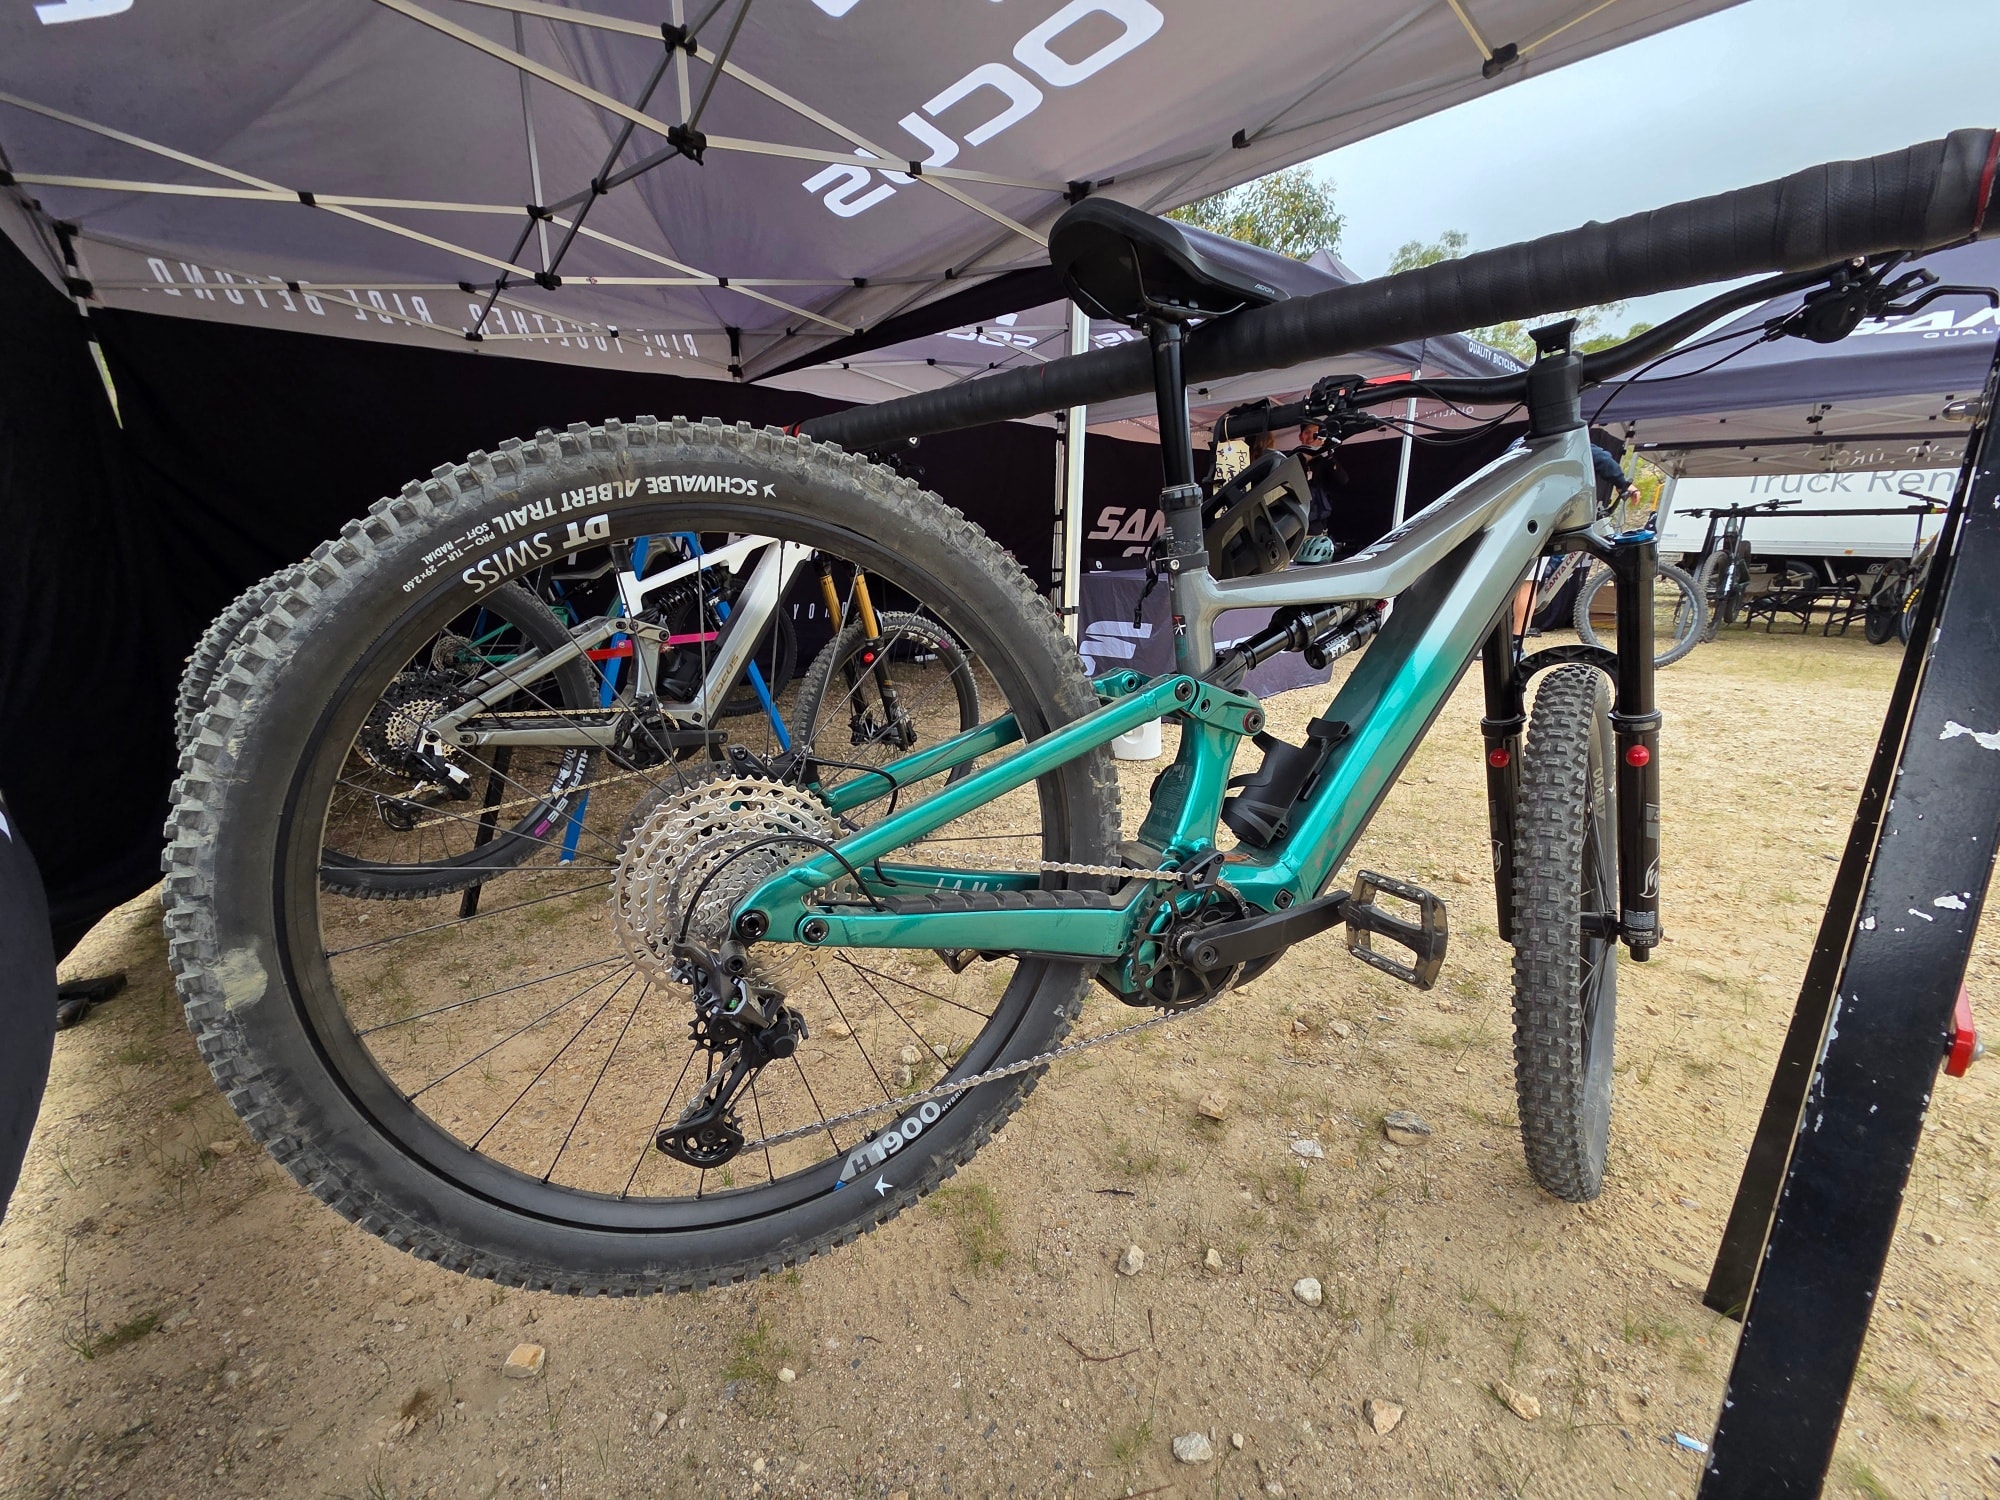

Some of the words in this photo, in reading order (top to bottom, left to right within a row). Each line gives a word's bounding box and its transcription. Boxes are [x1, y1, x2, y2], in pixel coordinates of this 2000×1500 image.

[1922, 327, 1994, 339] QUAL
[1468, 341, 1492, 361] QUALITY
[1492, 352, 1517, 373] BICYCLES
[560, 478, 642, 513] ALBERT
[646, 474, 757, 497] SCHWALBE
[1867, 470, 1957, 493] Ren
[466, 522, 490, 541] SOFT
[491, 497, 558, 535] TRAIL
[562, 513, 611, 549] DT
[1087, 506, 1166, 541] SAN
[420, 540, 455, 566] RADIAL
[475, 531, 496, 546] PRO
[448, 548, 464, 562] TLR
[462, 532, 553, 594] SWISS
[1544, 565, 1566, 594] SANTA
[1564, 551, 1579, 567] CRU
[1330, 638, 1352, 659] FOX
[711, 654, 739, 702] FOCUS
[852, 1101, 941, 1176] H1900
